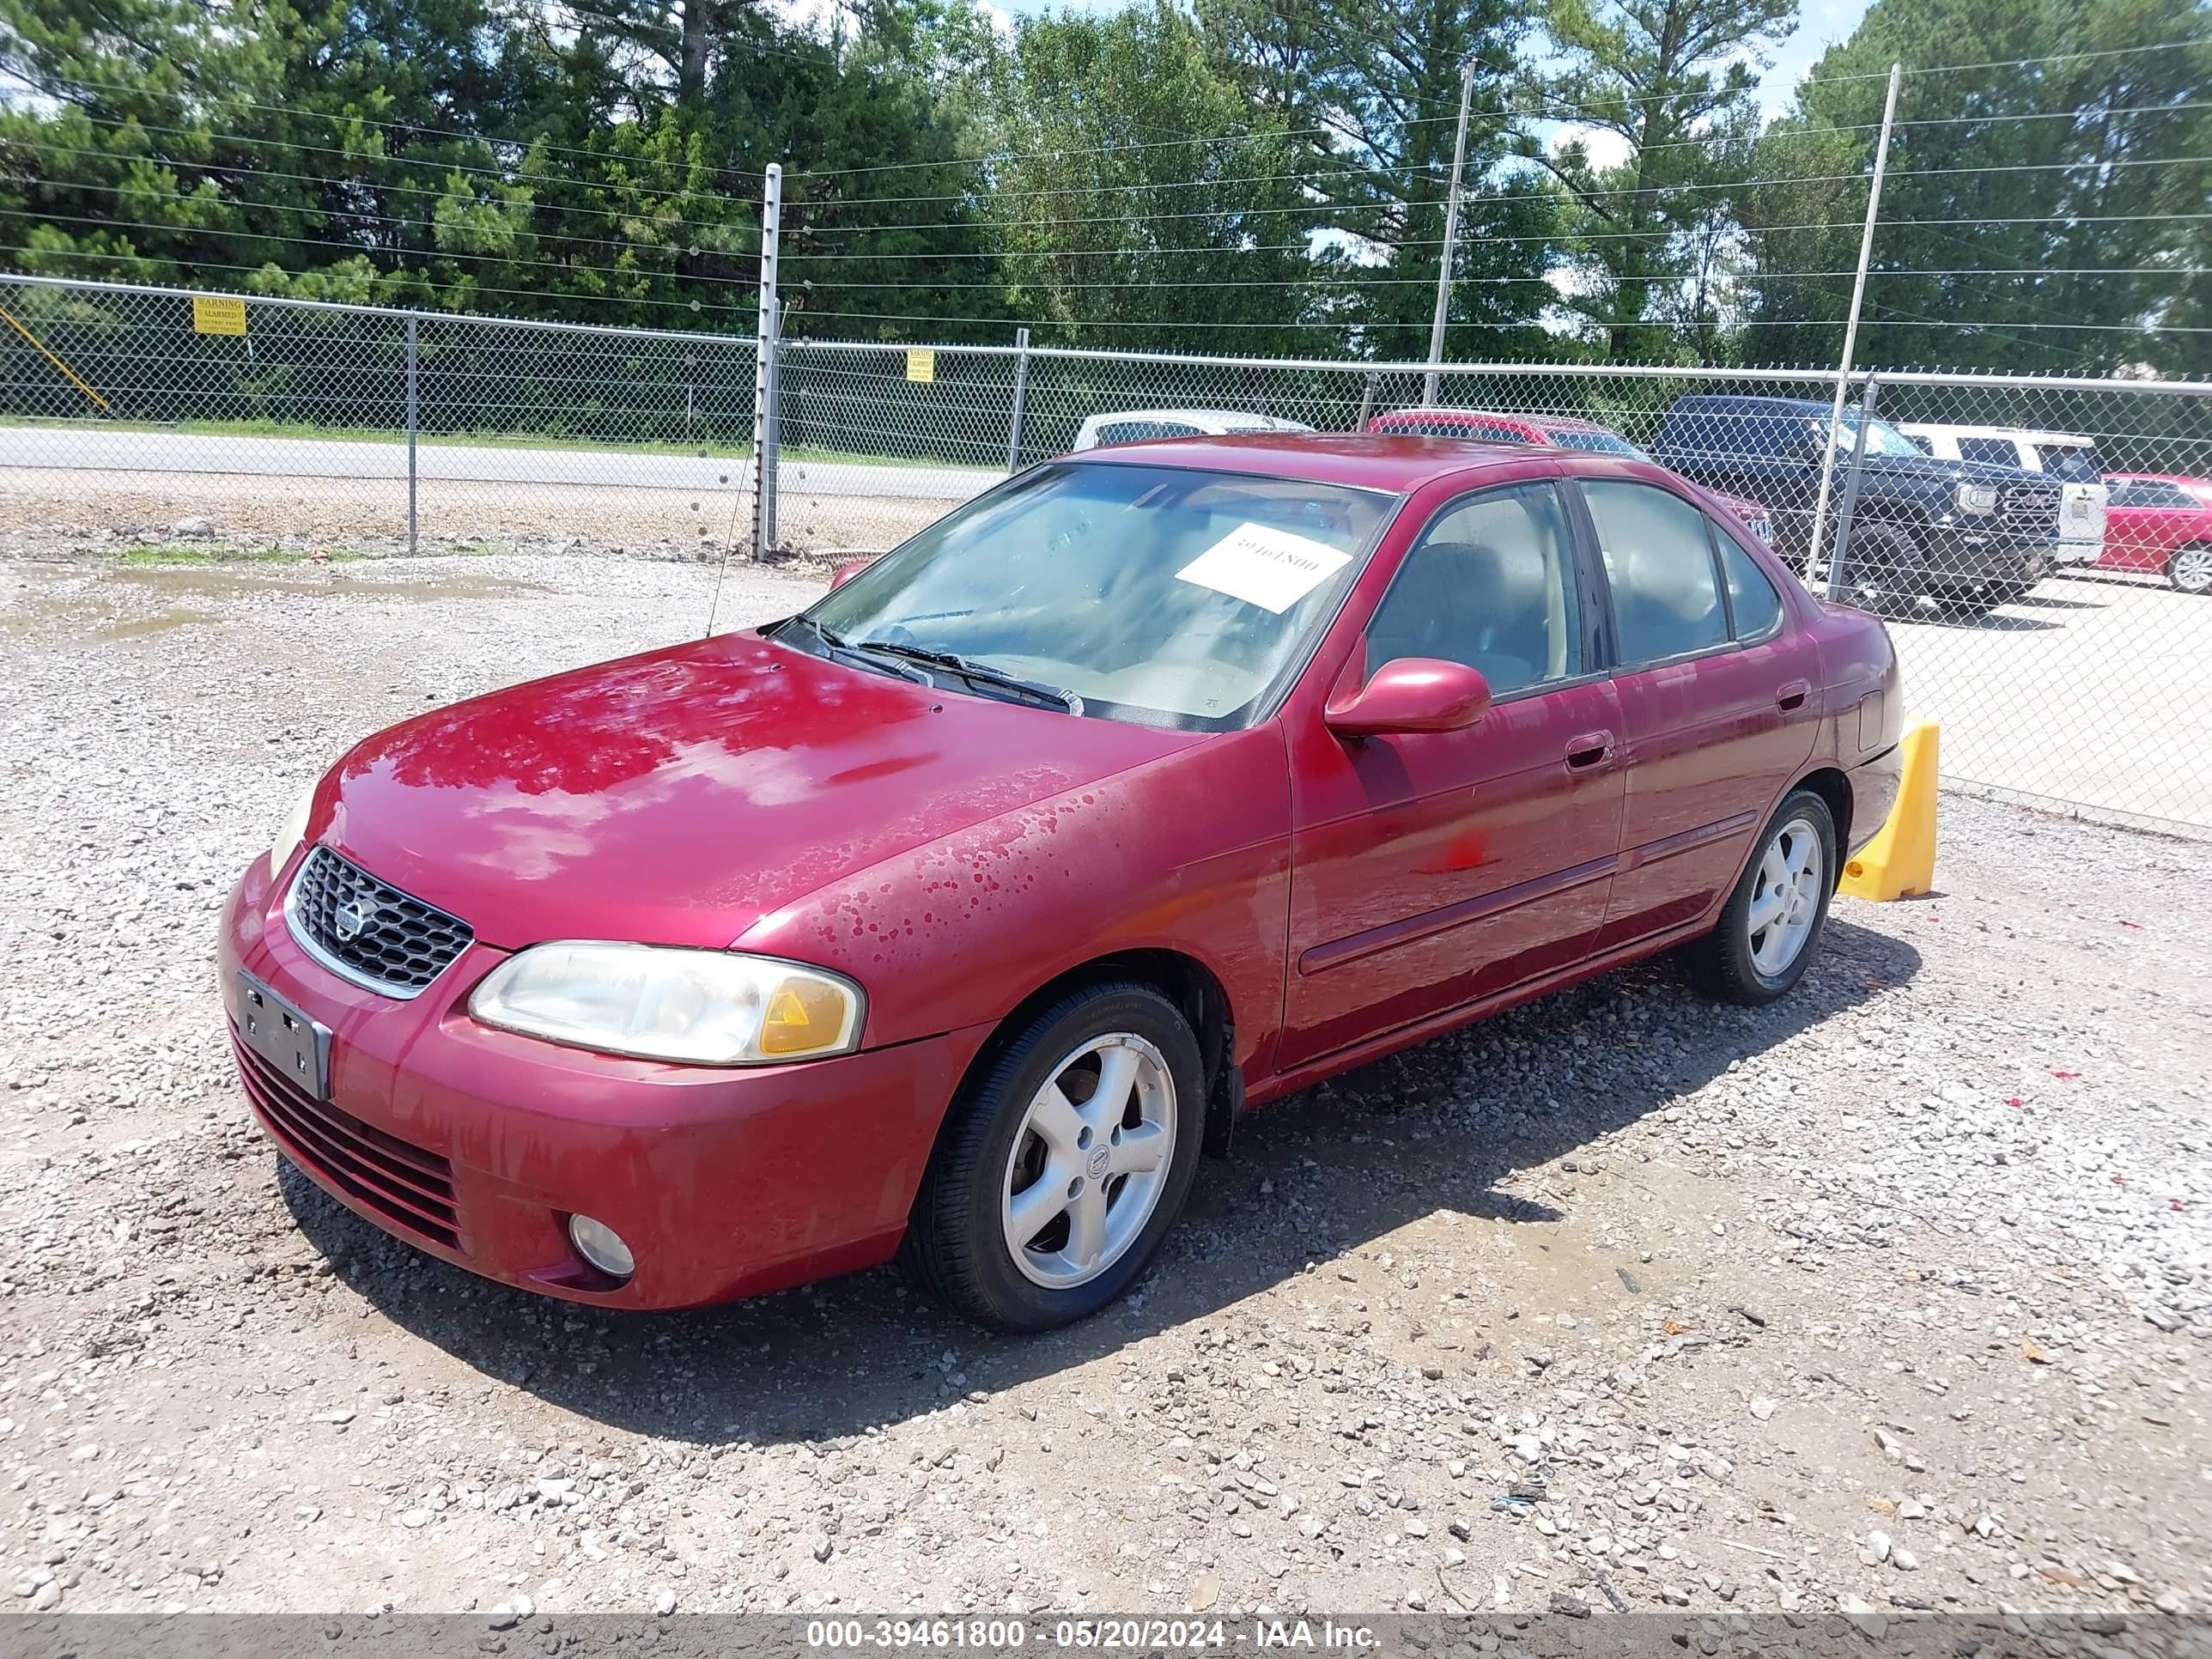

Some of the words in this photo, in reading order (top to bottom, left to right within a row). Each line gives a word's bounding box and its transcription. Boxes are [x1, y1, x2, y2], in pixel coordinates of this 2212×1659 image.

[198, 298, 240, 308] WARNING
[204, 310, 237, 319] ALARMED
[910, 349, 933, 358] WARNING
